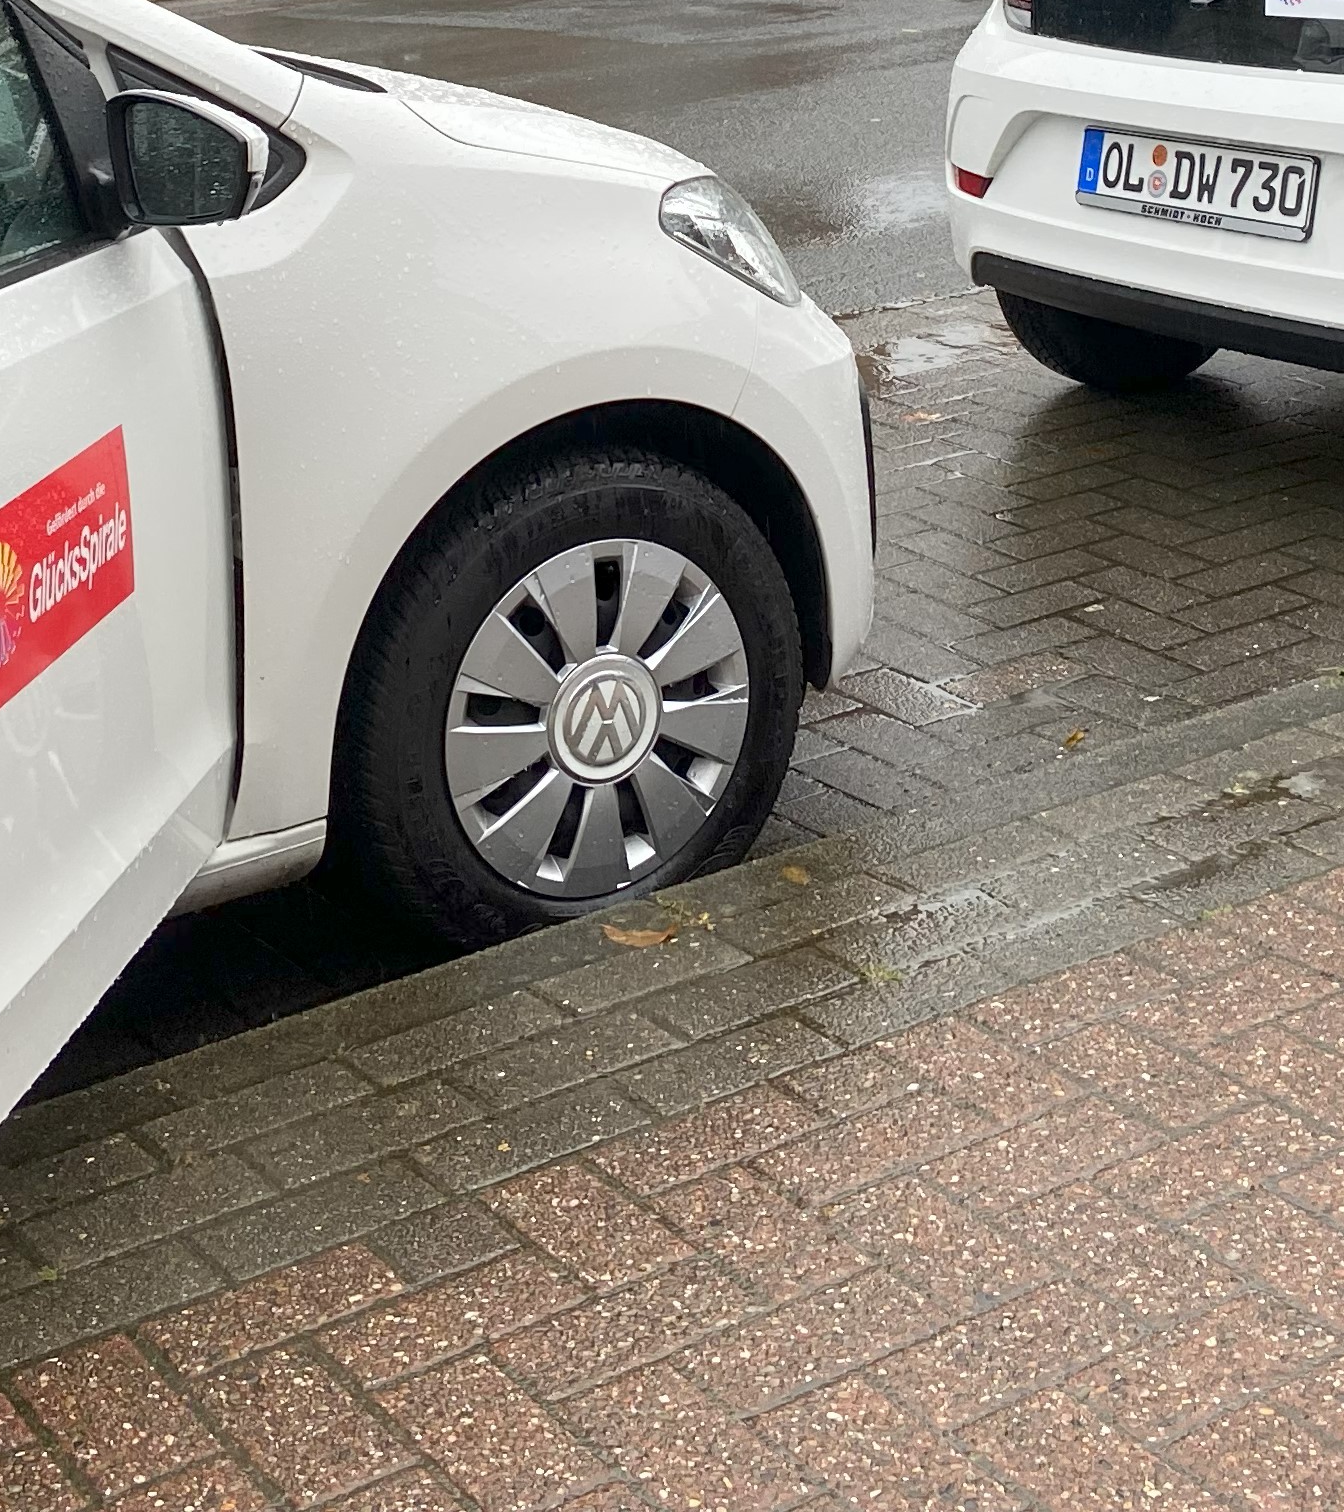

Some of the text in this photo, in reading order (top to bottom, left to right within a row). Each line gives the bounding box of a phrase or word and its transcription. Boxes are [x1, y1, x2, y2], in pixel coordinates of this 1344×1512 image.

[1085, 141, 1307, 217] D OL DW 730
[1140, 204, 1186, 220] SCHMIDT
[1192, 212, 1223, 226] KOCH
[77, 488, 96, 513] durch
[95, 481, 106, 500] die
[29, 501, 127, 623] GlücksSpirale
